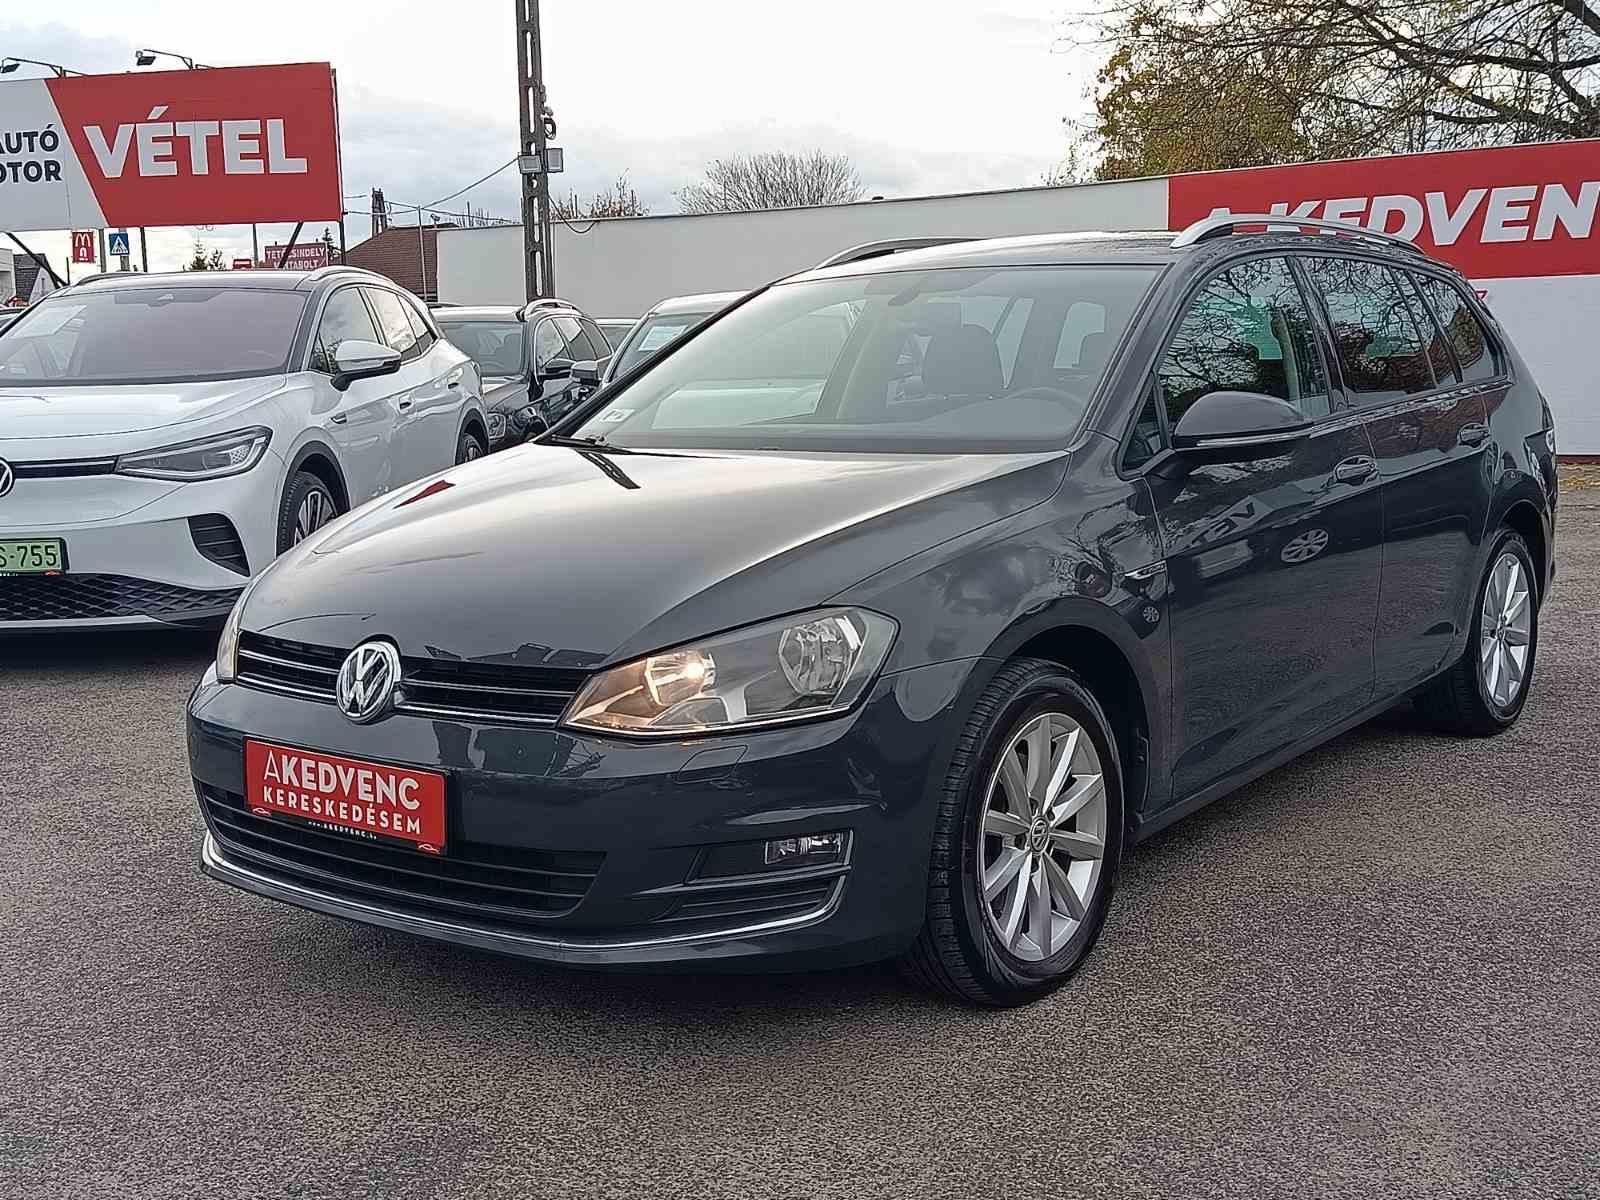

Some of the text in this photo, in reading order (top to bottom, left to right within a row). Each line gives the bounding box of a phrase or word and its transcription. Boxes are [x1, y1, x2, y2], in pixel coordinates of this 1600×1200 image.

[0, 124, 59, 154] UTÓ
[83, 106, 307, 178] VÉTEL
[266, 247, 325, 259] TETSINDELY
[264, 750, 420, 810] AKEDVENC
[263, 785, 421, 834] KERESKEDÉSEM
